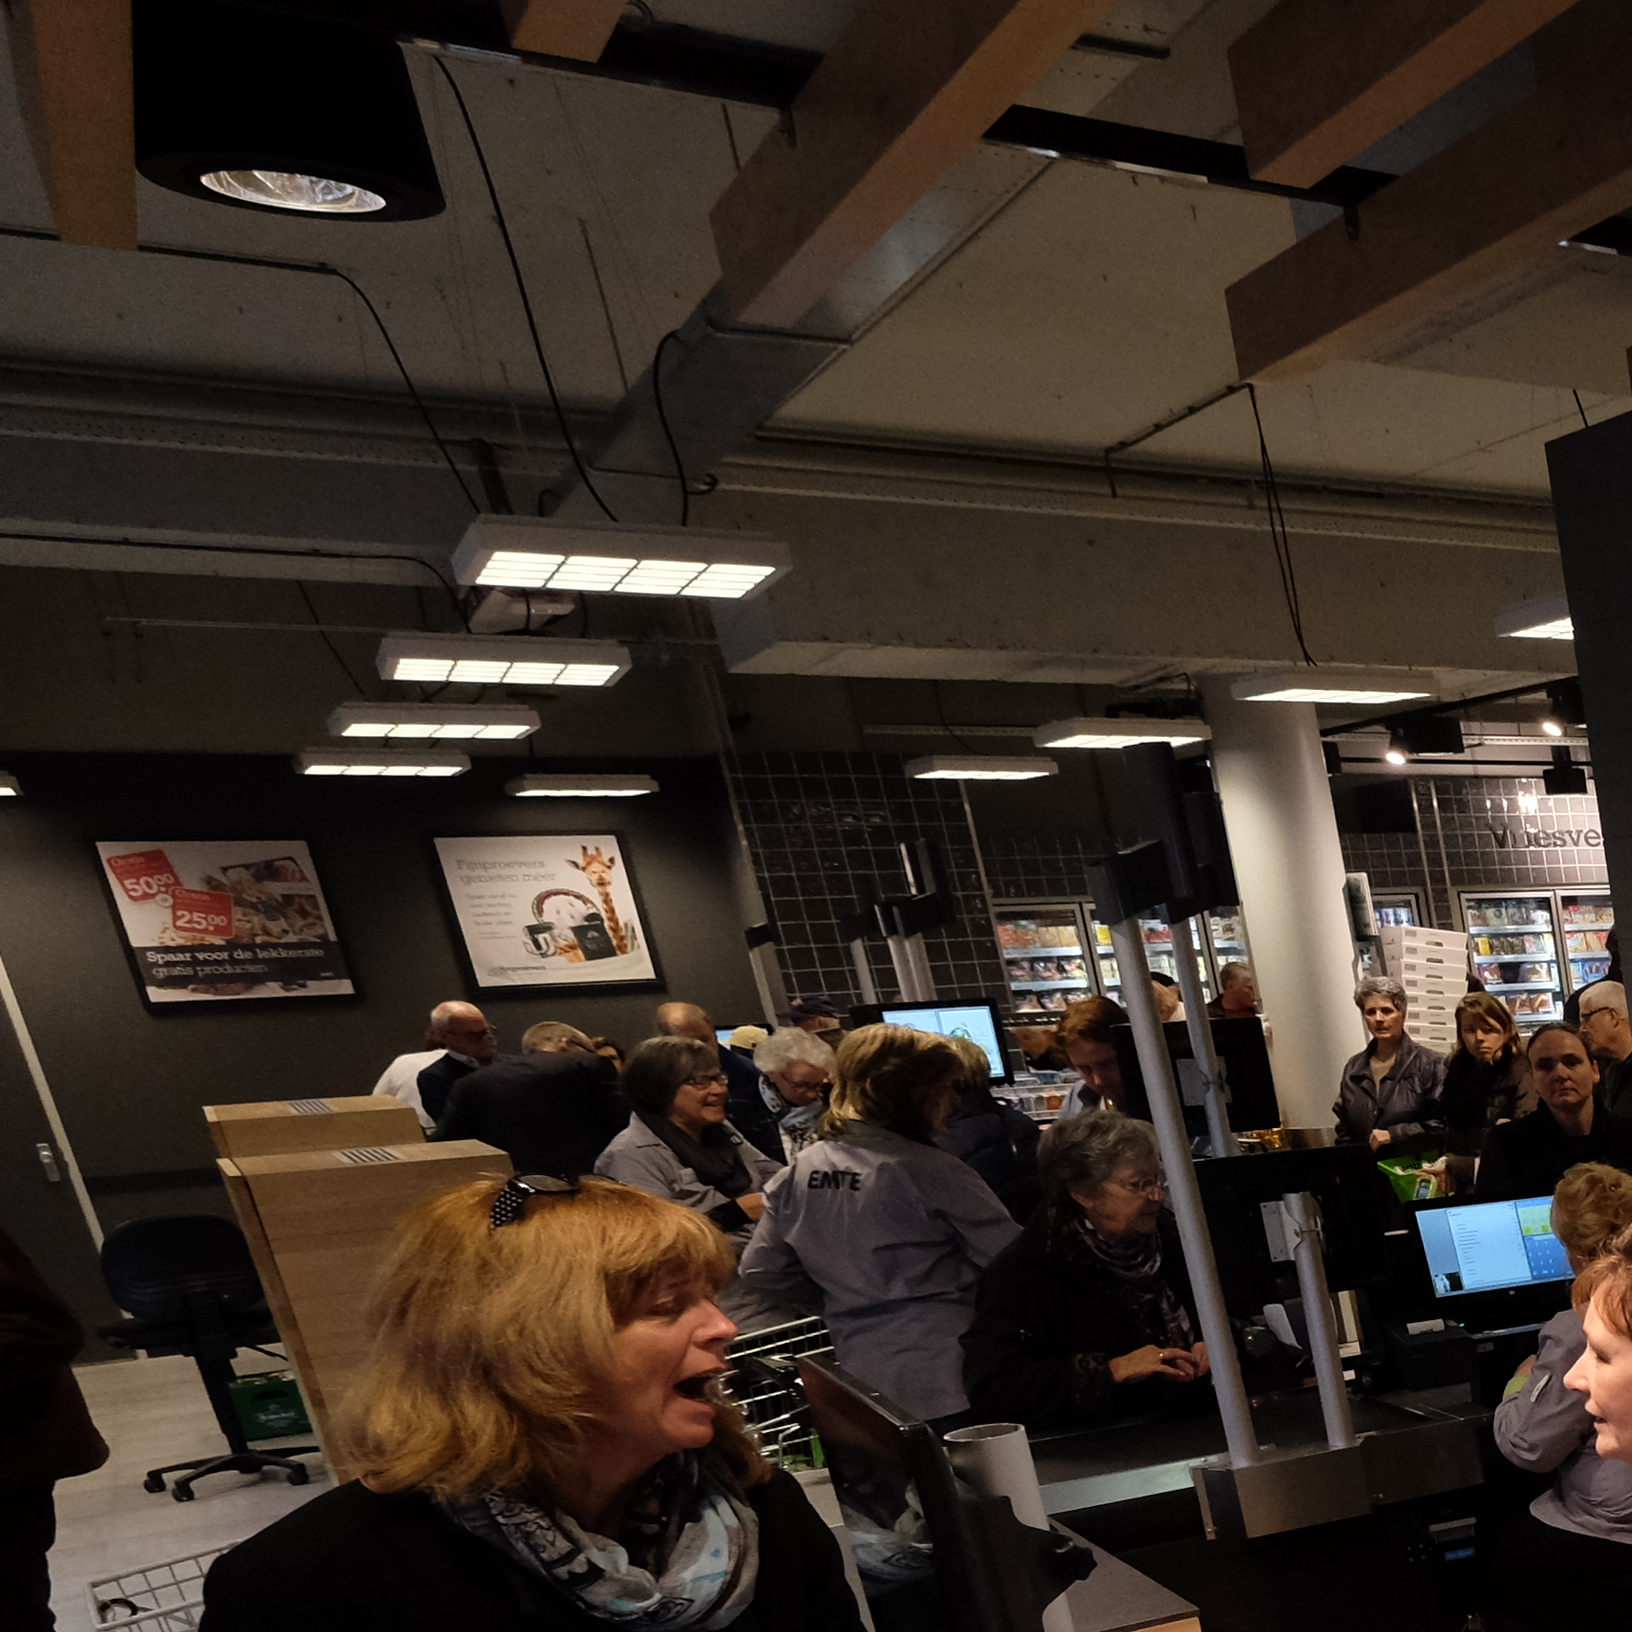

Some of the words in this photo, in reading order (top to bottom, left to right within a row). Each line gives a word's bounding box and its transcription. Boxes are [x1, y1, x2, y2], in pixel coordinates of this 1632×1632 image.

[461, 873, 518, 885] genieten
[147, 951, 191, 964] Spaar
[196, 950, 229, 961] voor
[234, 948, 253, 960] de
[153, 965, 194, 979] gratis
[196, 963, 268, 977] producten
